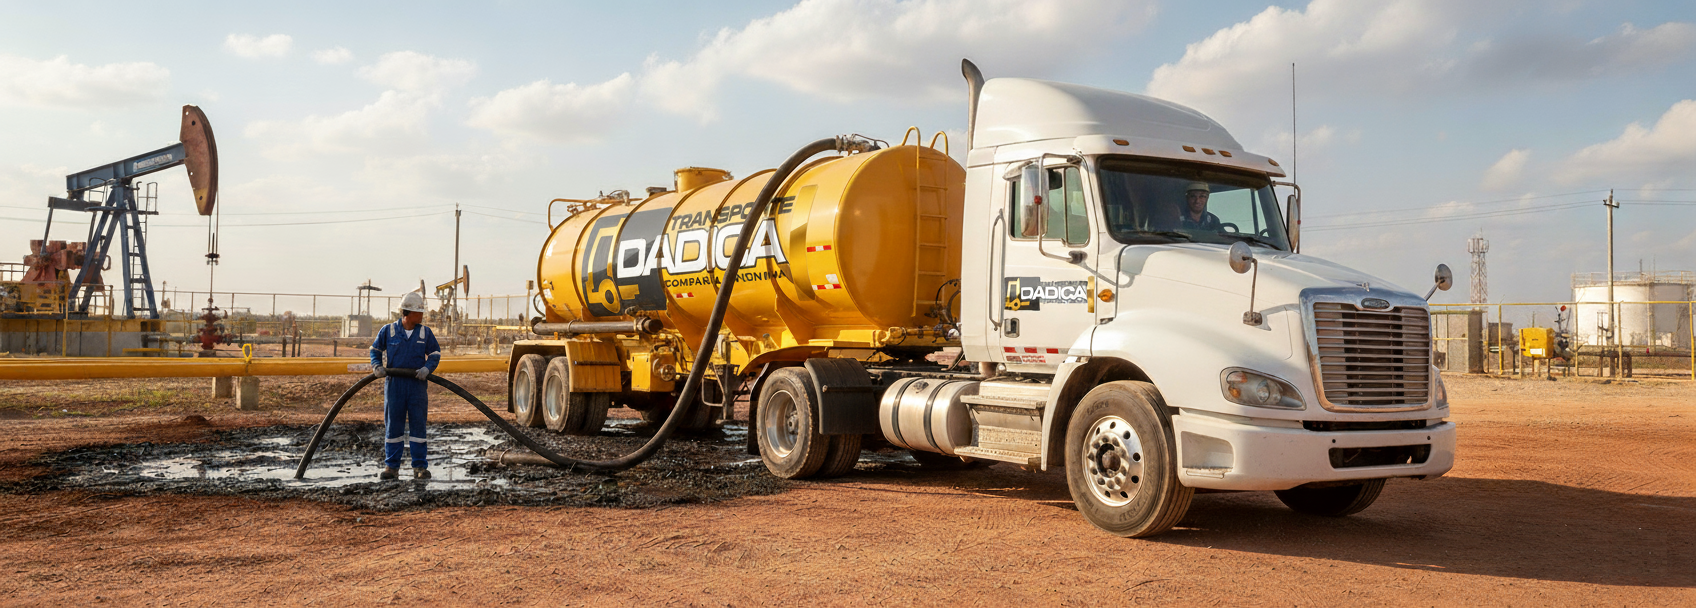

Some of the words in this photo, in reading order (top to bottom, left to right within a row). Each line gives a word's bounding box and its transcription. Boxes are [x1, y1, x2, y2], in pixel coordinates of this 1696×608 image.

[671, 196, 796, 231] TRANSPOTE
[616, 217, 787, 279] DADICA
[1020, 285, 1087, 300] DADICA
